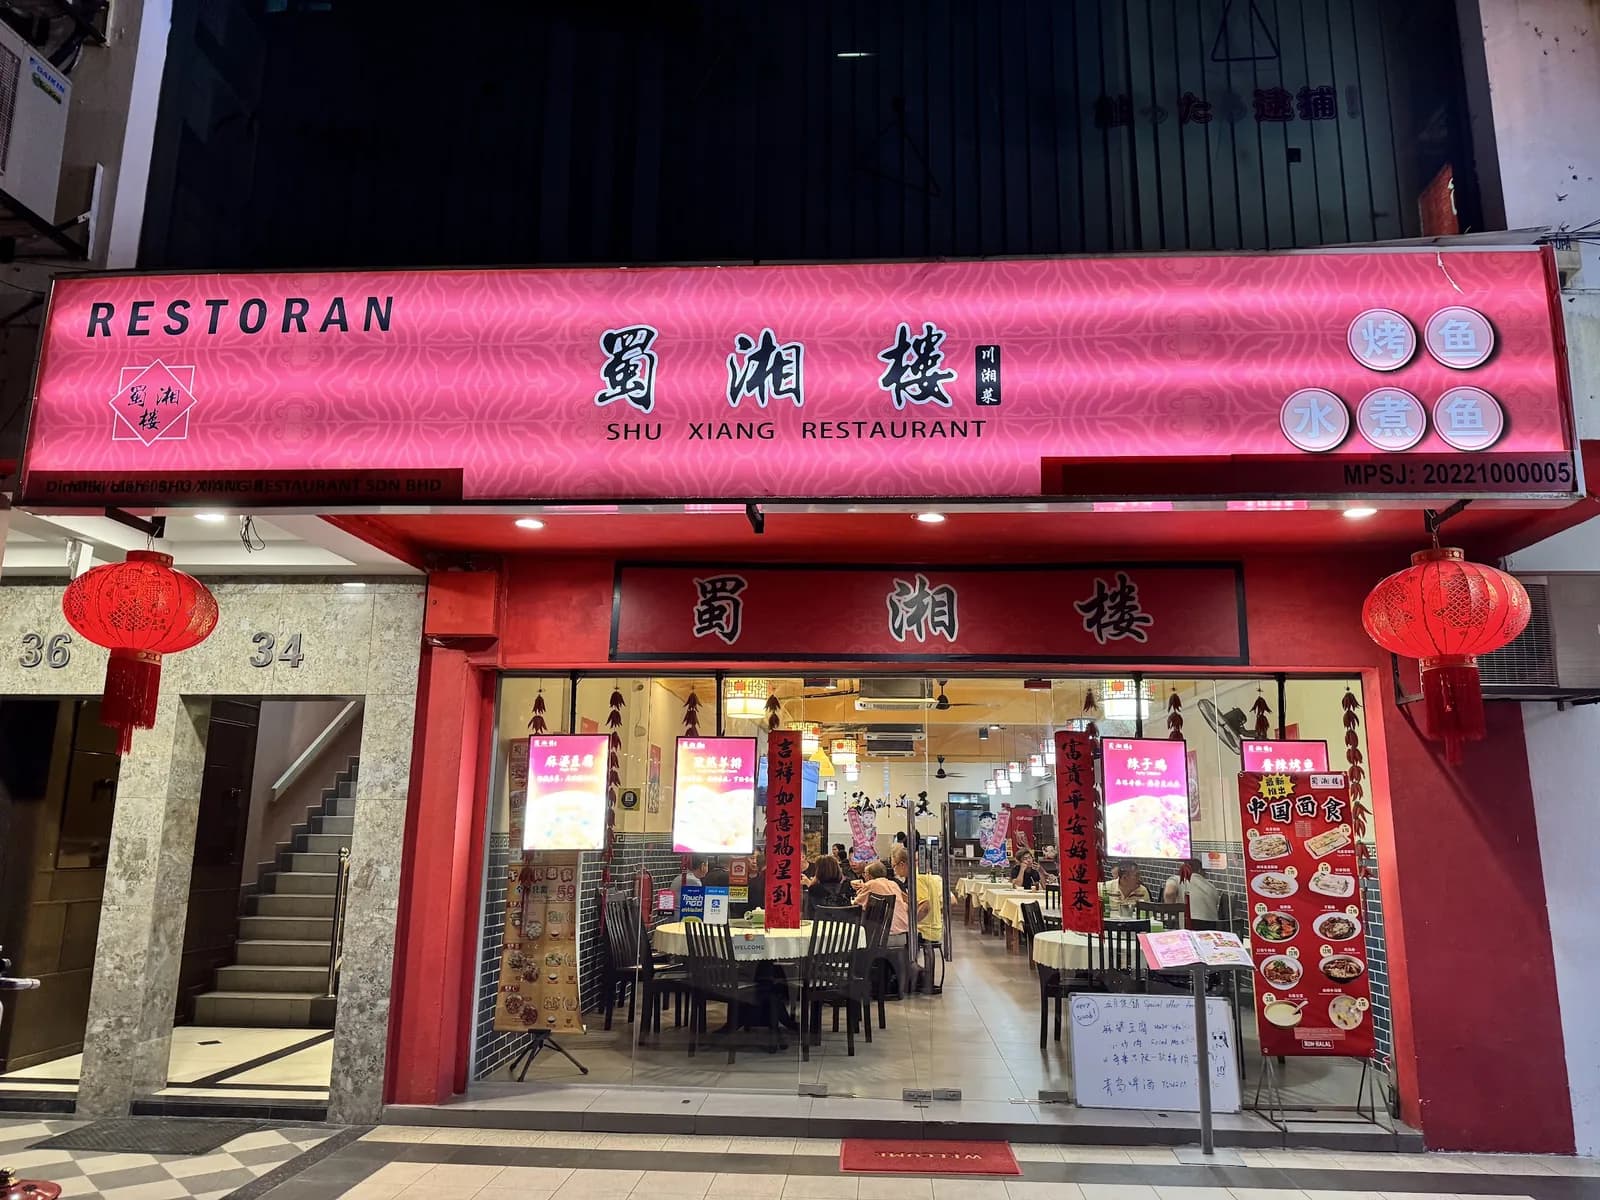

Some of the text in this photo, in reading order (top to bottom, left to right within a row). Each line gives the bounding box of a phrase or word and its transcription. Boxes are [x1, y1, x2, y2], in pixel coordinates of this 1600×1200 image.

[87, 296, 394, 338] RESTORAN
[1361, 319, 1482, 360] 烤鱼
[980, 346, 999, 404] 川湘菜
[606, 419, 987, 441] SHU XIANG RESTAURANT
[1293, 396, 1489, 438] 水煮鱼
[1423, 462, 1571, 484] 20221000005
[18, 632, 73, 669] 36
[249, 632, 305, 669] 34
[1247, 794, 1346, 824] 中国面食
